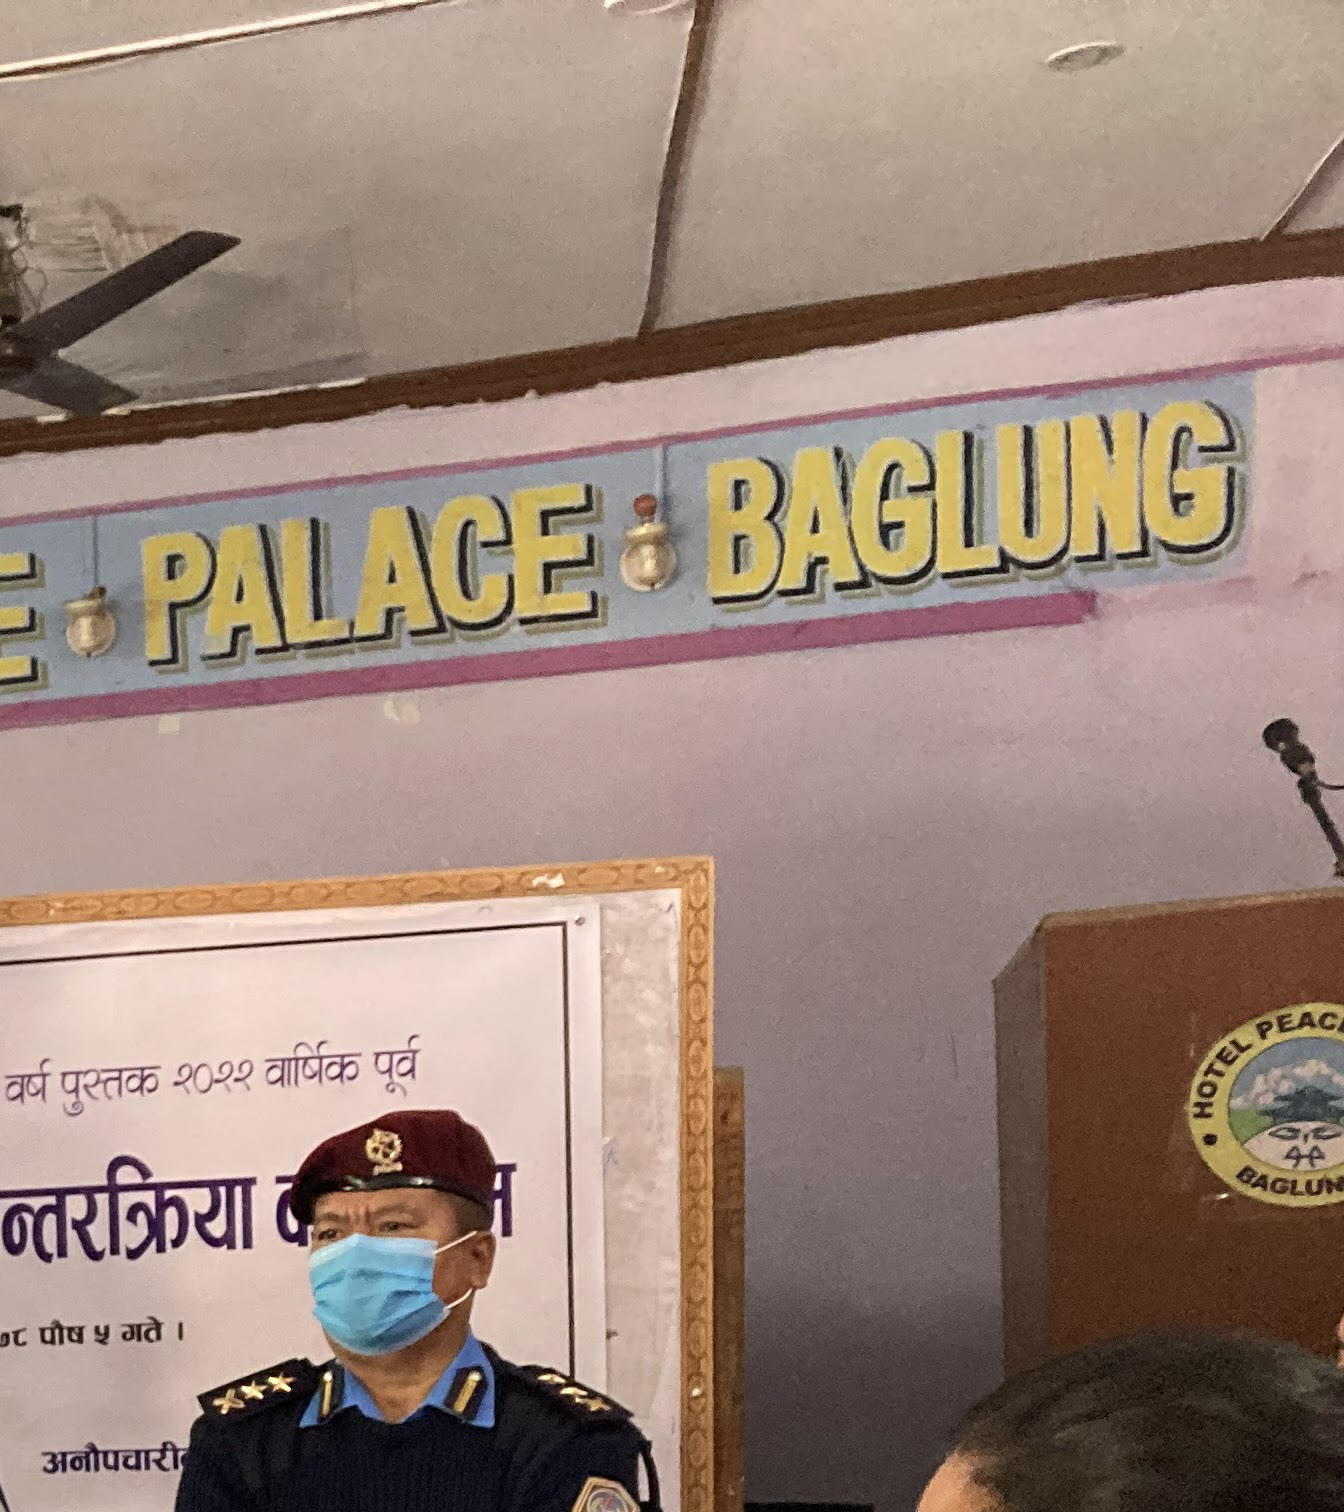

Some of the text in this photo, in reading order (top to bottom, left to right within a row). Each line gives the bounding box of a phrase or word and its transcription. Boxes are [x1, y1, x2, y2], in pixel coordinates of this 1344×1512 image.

[142, 483, 605, 672] PALACE
[706, 399, 1246, 610] BAGLUNG
[5, 1057, 51, 1104] वर्ष
[62, 1065, 161, 1116] पुस्तक
[173, 1059, 254, 1095] २०२२
[265, 1040, 362, 1088] वार्षिक
[373, 1034, 421, 1096] पूर्व
[1192, 1038, 1252, 1119] HOTEL
[38, 1319, 85, 1346] पौष
[94, 1324, 110, 1346] ५
[121, 1316, 164, 1343] गते
[41, 1440, 190, 1474] अनौपचारी
